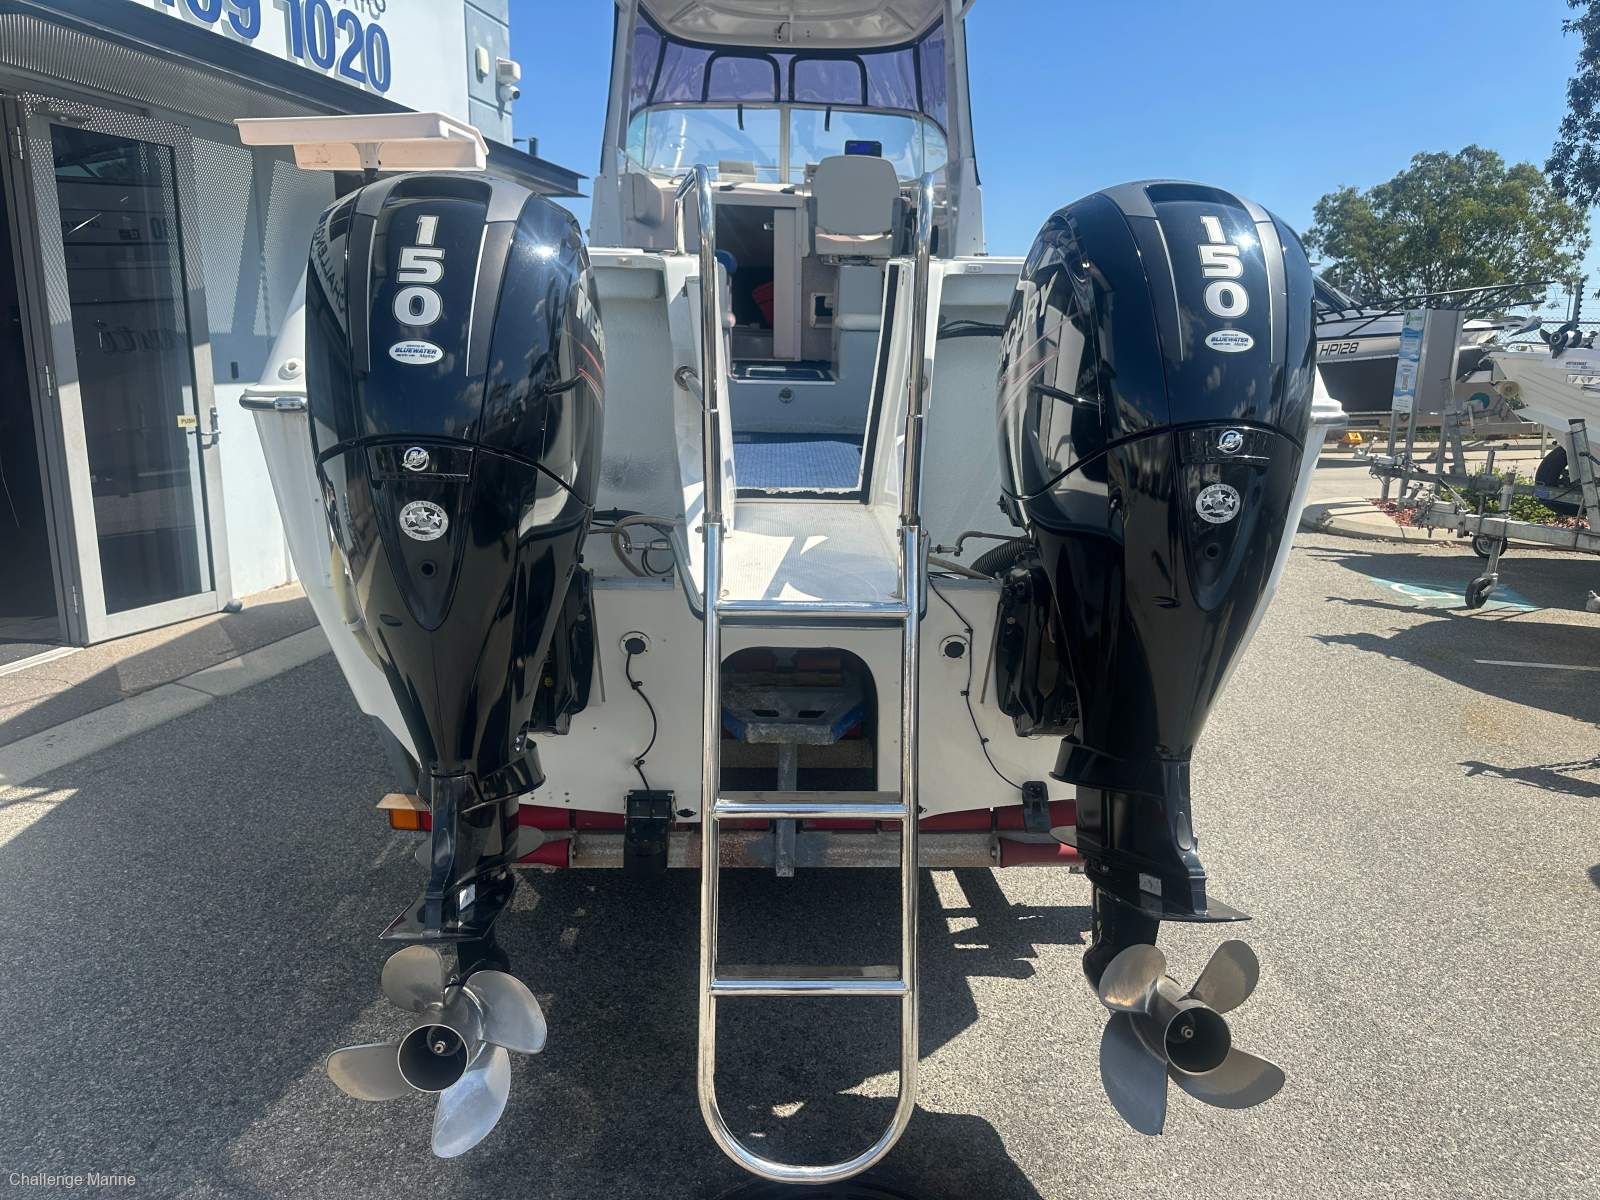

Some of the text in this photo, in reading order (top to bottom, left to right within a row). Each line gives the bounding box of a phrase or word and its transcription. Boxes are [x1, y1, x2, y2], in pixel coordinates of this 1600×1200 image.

[286, 0, 391, 93] 1020
[391, 214, 445, 327] 150
[1197, 215, 1249, 318] 150
[1320, 342, 1359, 356] HP128
